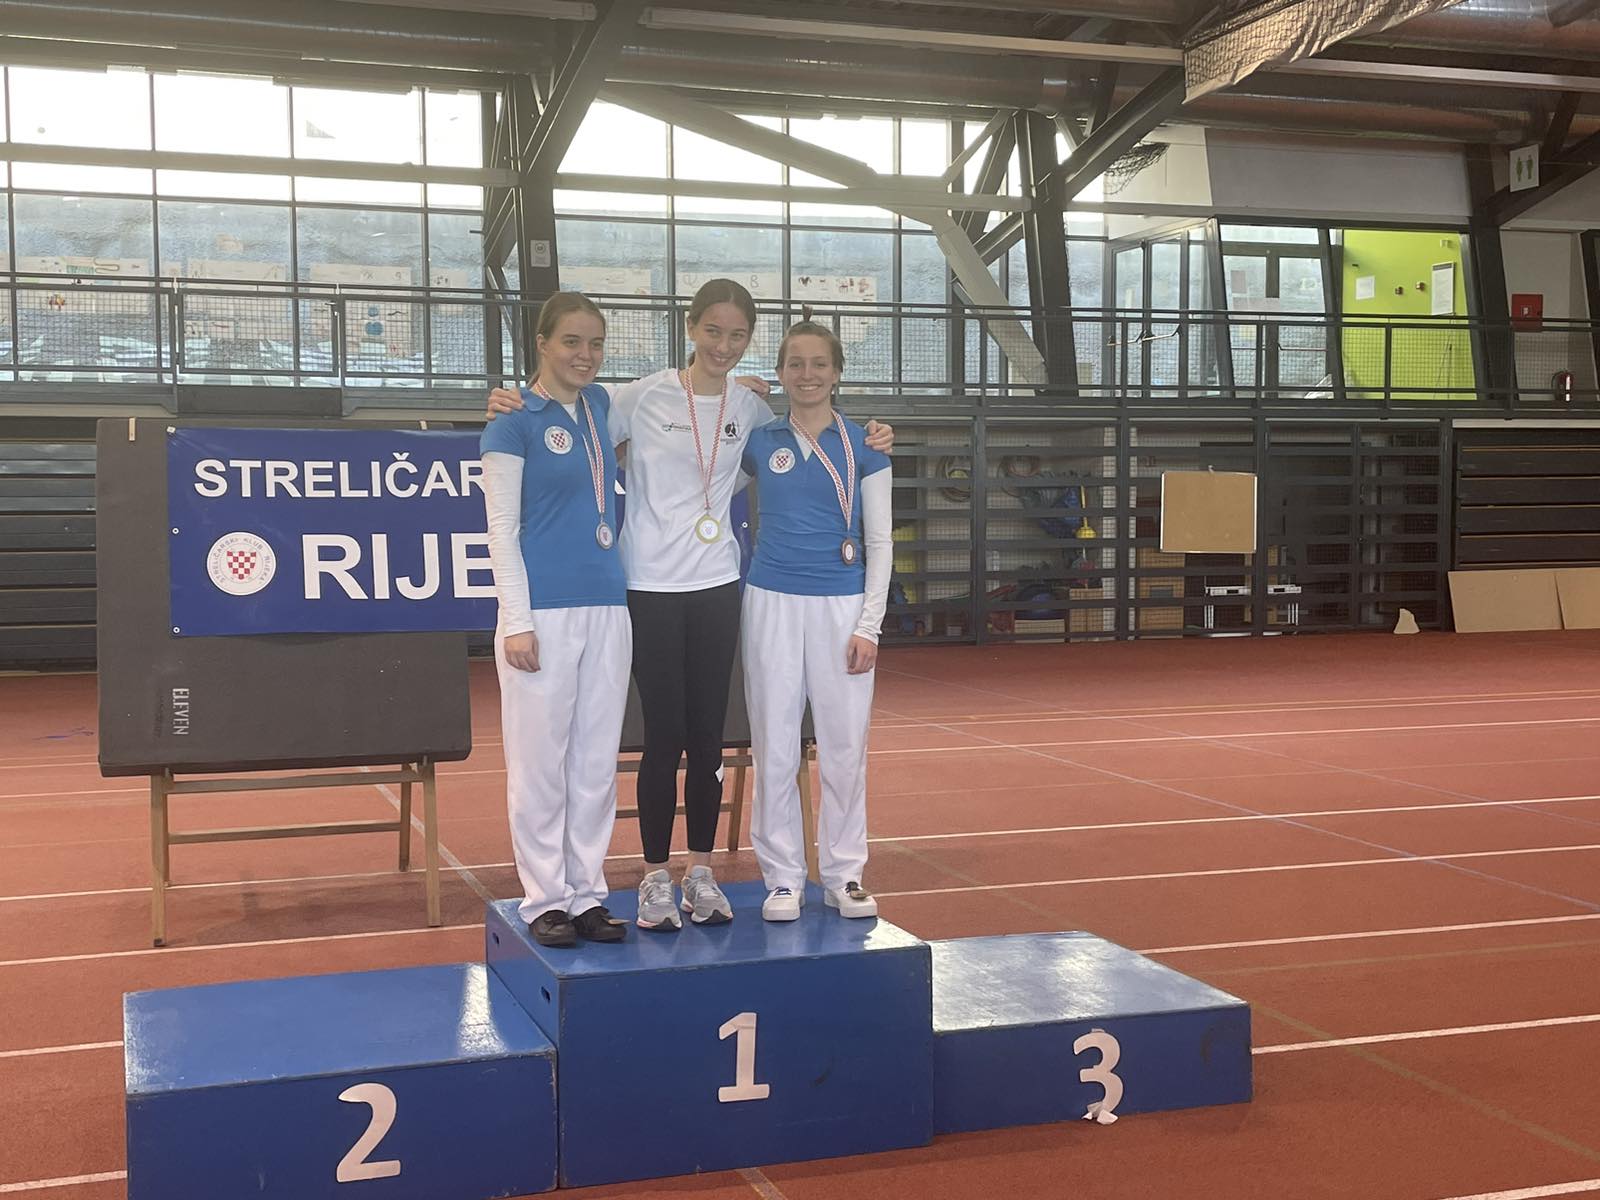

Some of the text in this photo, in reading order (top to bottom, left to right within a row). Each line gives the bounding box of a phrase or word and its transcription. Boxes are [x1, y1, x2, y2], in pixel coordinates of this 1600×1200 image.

[172, 687, 190, 735] ELEVEN
[718, 1012, 770, 1103] 1
[1073, 1028, 1124, 1124] 3
[336, 1082, 401, 1182] 2
